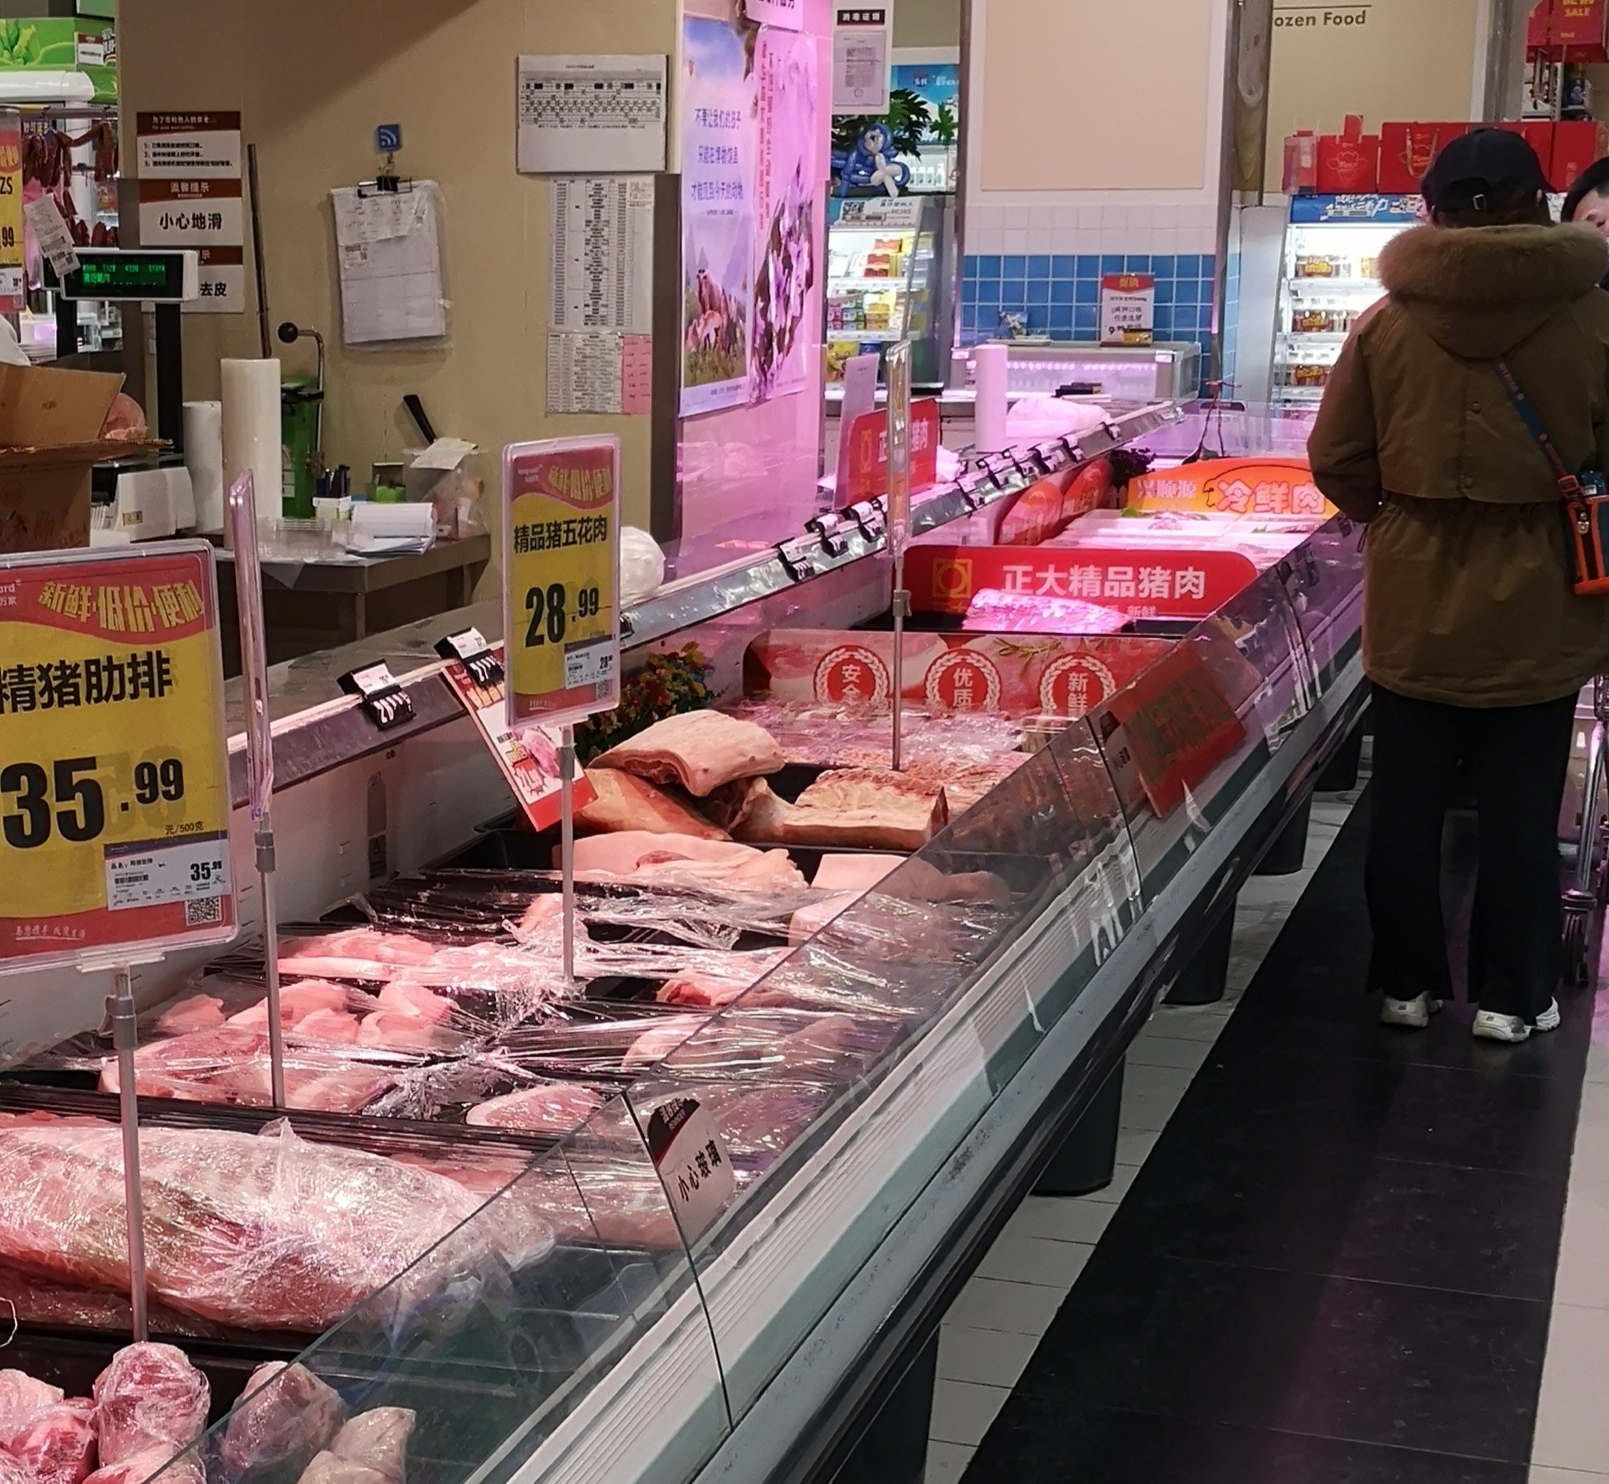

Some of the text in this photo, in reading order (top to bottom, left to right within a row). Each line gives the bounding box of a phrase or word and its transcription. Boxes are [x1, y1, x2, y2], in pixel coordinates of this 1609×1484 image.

[1273, 9, 1366, 27] ozen Food
[159, 212, 223, 230] 小心地滑
[1216, 479, 1326, 514] 冷鲜肉
[513, 514, 608, 554] 精品猪五花肉
[1001, 564, 1206, 600] 正大精品猪肉
[525, 582, 600, 648] 28.99
[0, 650, 173, 715] 精猪肋排
[1, 756, 185, 850] 35.99
[164, 821, 204, 835] 元/500克
[190, 860, 223, 881] 35.99
[677, 1138, 722, 1202] 小心玻璃
